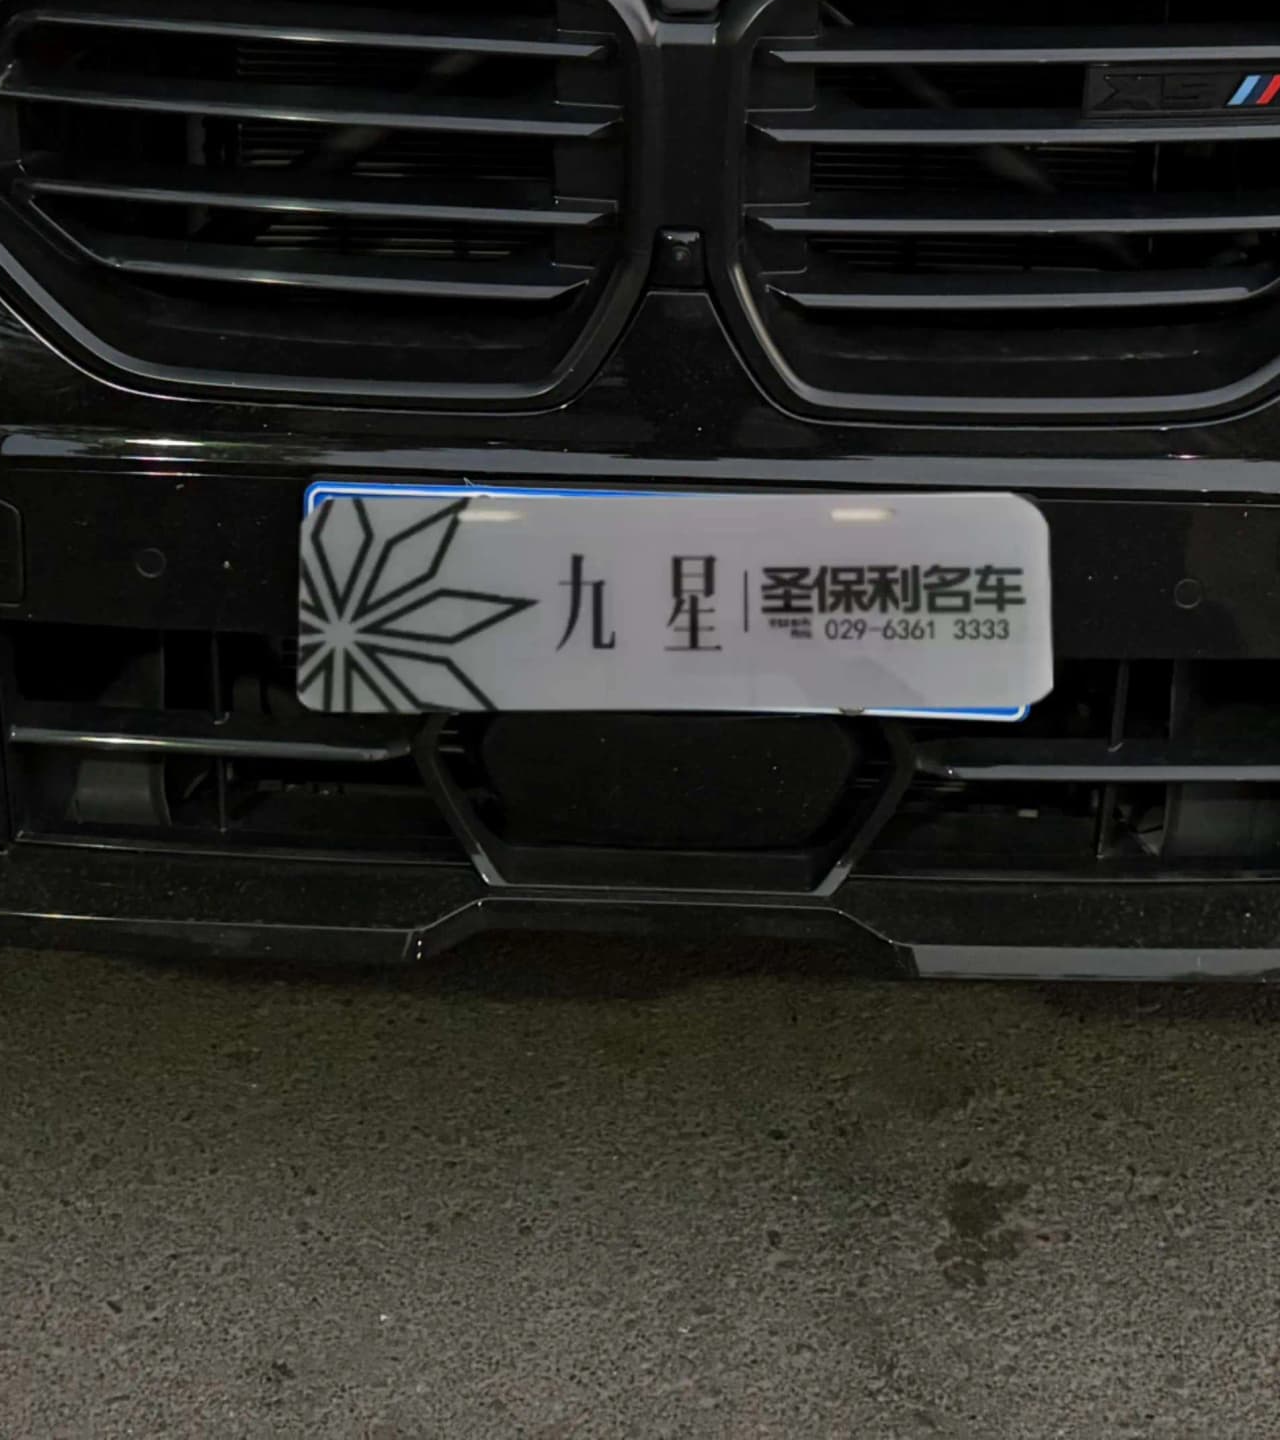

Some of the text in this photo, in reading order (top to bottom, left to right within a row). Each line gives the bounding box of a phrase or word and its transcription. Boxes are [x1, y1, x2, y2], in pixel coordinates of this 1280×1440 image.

[556, 553, 723, 652] 九星
[761, 564, 1026, 614] 圣保利名车
[824, 618, 935, 641] 029-6361
[953, 618, 1010, 641] 3333
